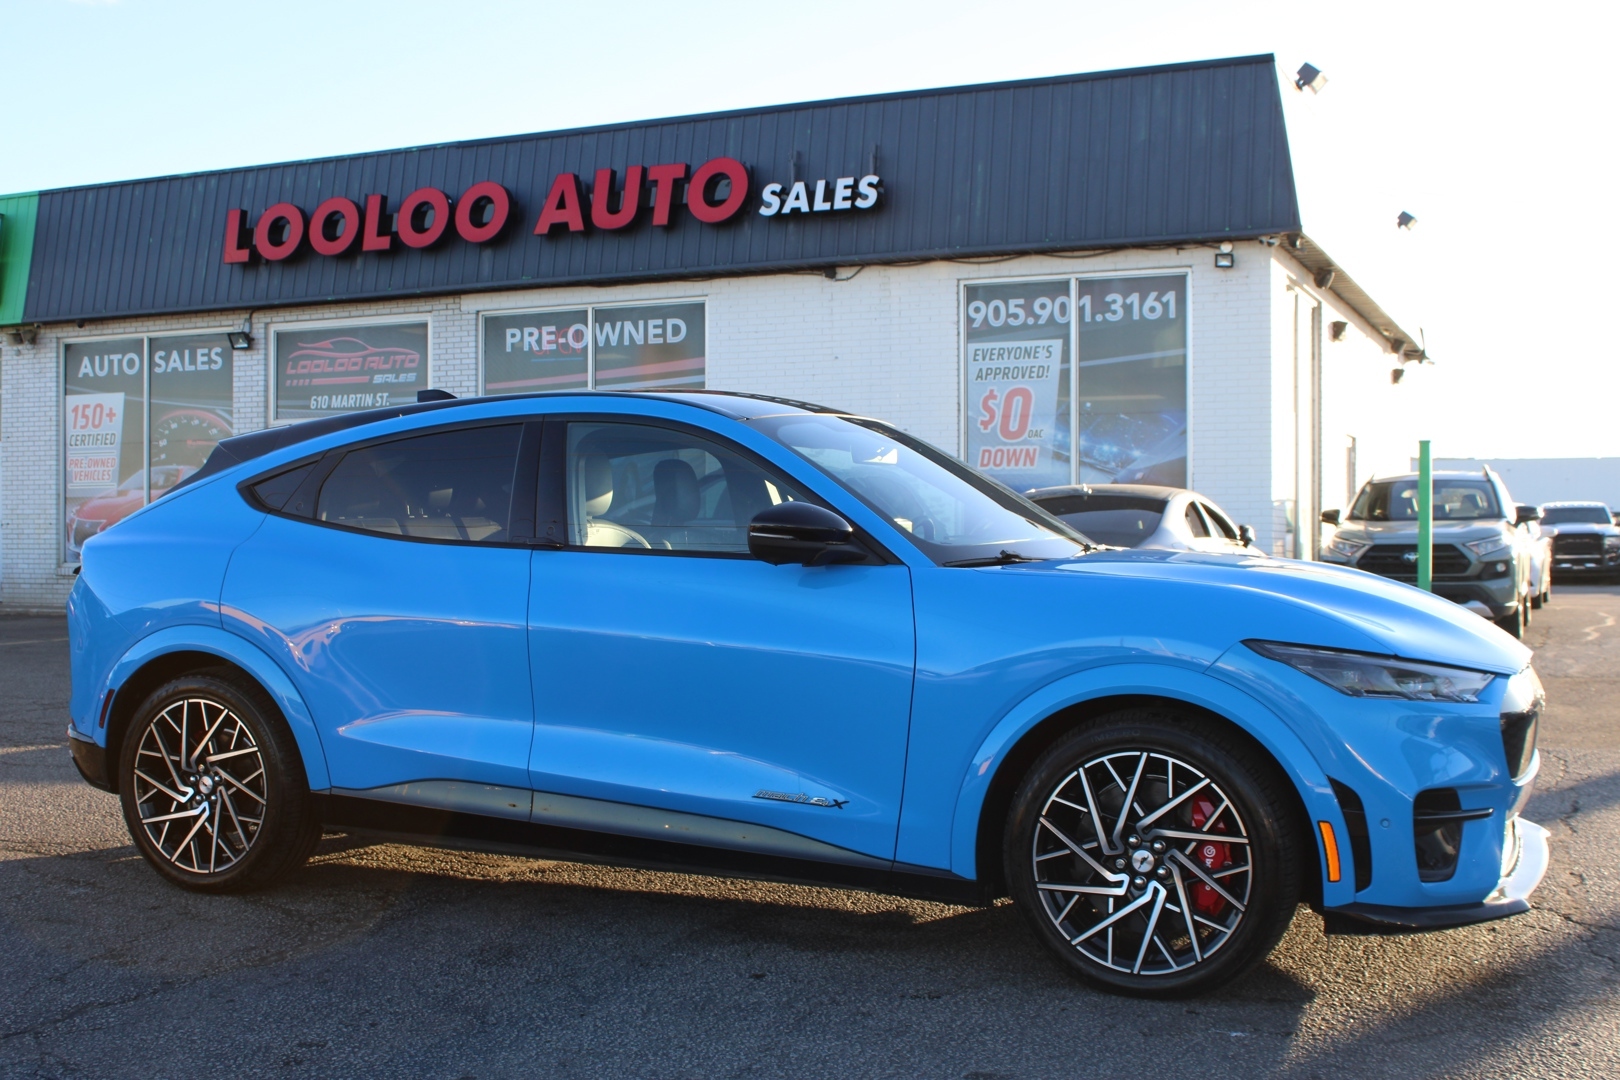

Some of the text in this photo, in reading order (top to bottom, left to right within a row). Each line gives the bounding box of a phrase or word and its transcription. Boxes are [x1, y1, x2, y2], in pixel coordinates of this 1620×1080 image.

[223, 157, 881, 264] LOOLOO AUTO SALES
[968, 291, 1176, 328] 905.901.3161
[505, 317, 687, 352] PRE-OWNED
[78, 347, 223, 378] AUTO SALES
[973, 344, 1053, 363] EVERYONE'S
[286, 354, 420, 375] LOOLOO AUTO
[975, 365, 1050, 382] APPROVED!
[372, 373, 417, 384] SALES
[310, 392, 390, 409] 610 MARTIN ST.
[71, 403, 117, 430] 150+
[979, 386, 1033, 441] $0
[69, 433, 116, 447] CERTIFIED
[1027, 429, 1043, 439] OAC
[68, 457, 117, 469] PRE-OWNED
[980, 447, 1038, 468] DOWN
[73, 469, 112, 482] VEHICLES
